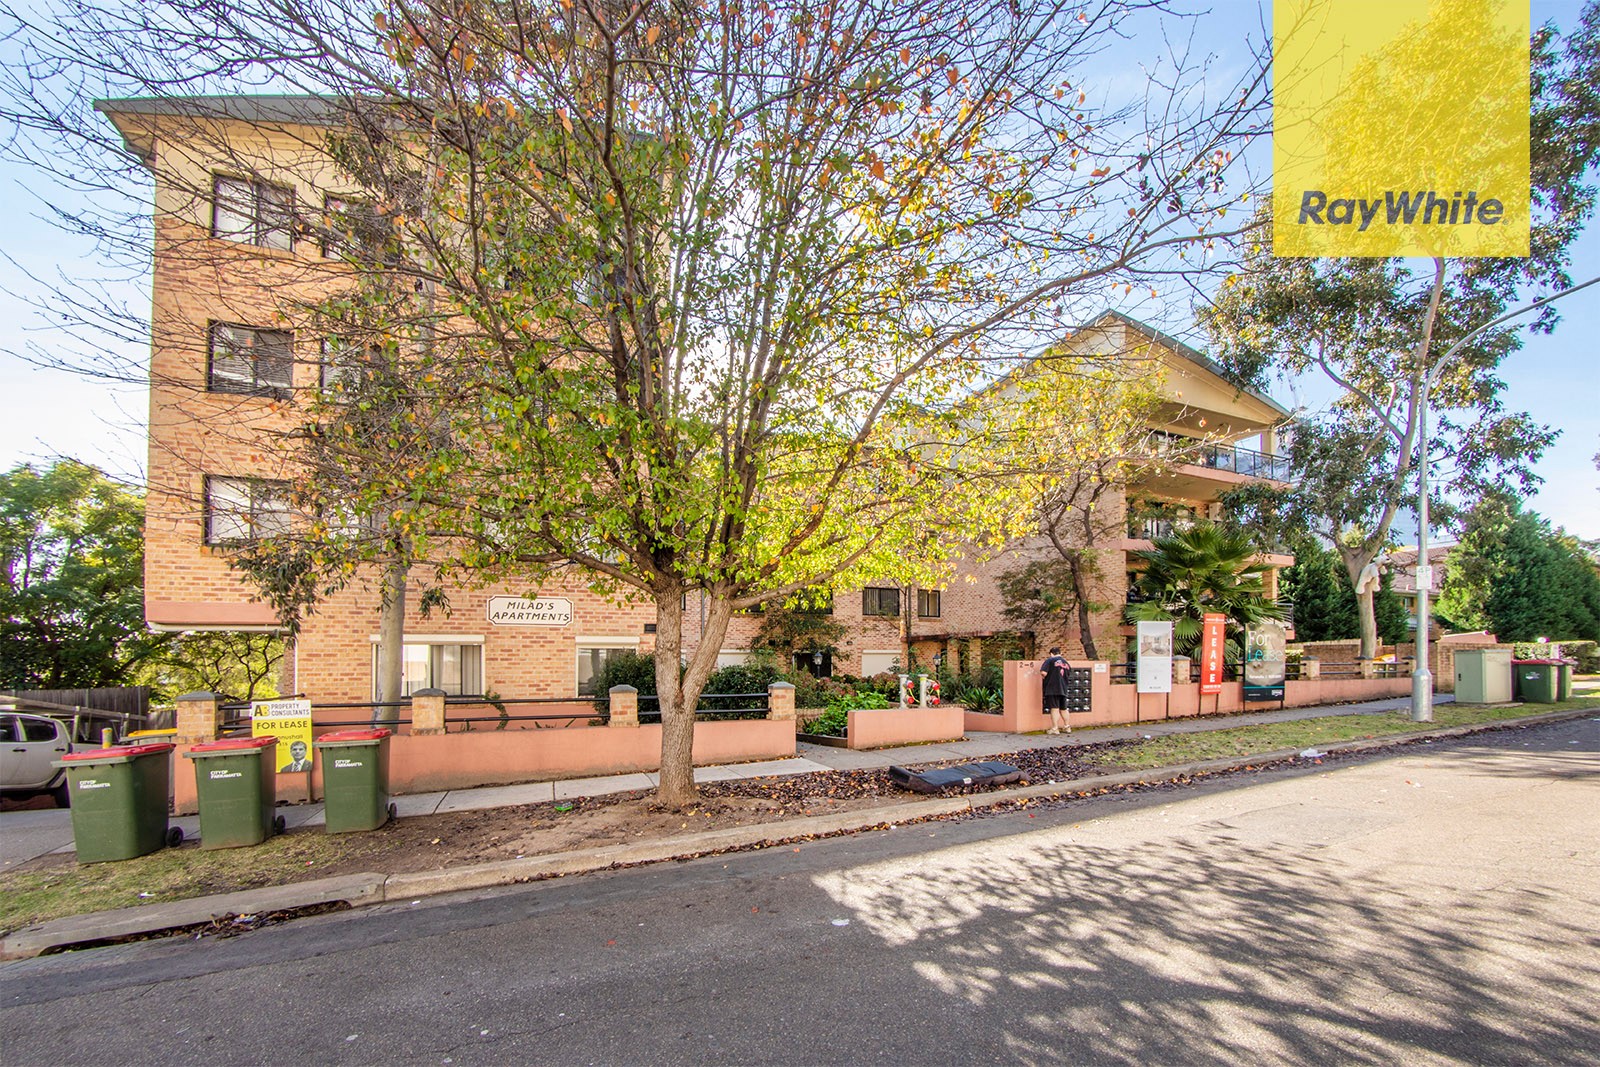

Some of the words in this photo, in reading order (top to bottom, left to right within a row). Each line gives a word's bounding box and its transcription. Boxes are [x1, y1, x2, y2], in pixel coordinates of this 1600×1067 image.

[507, 601, 554, 610] MILAD'S
[492, 611, 570, 621] APARTMENTS
[1248, 631, 1271, 646] For
[1209, 625, 1218, 683] LEASE
[1247, 646, 1283, 662] Lease
[254, 704, 270, 717] AB
[256, 721, 276, 729] FOR
[280, 720, 308, 728] LEASE
